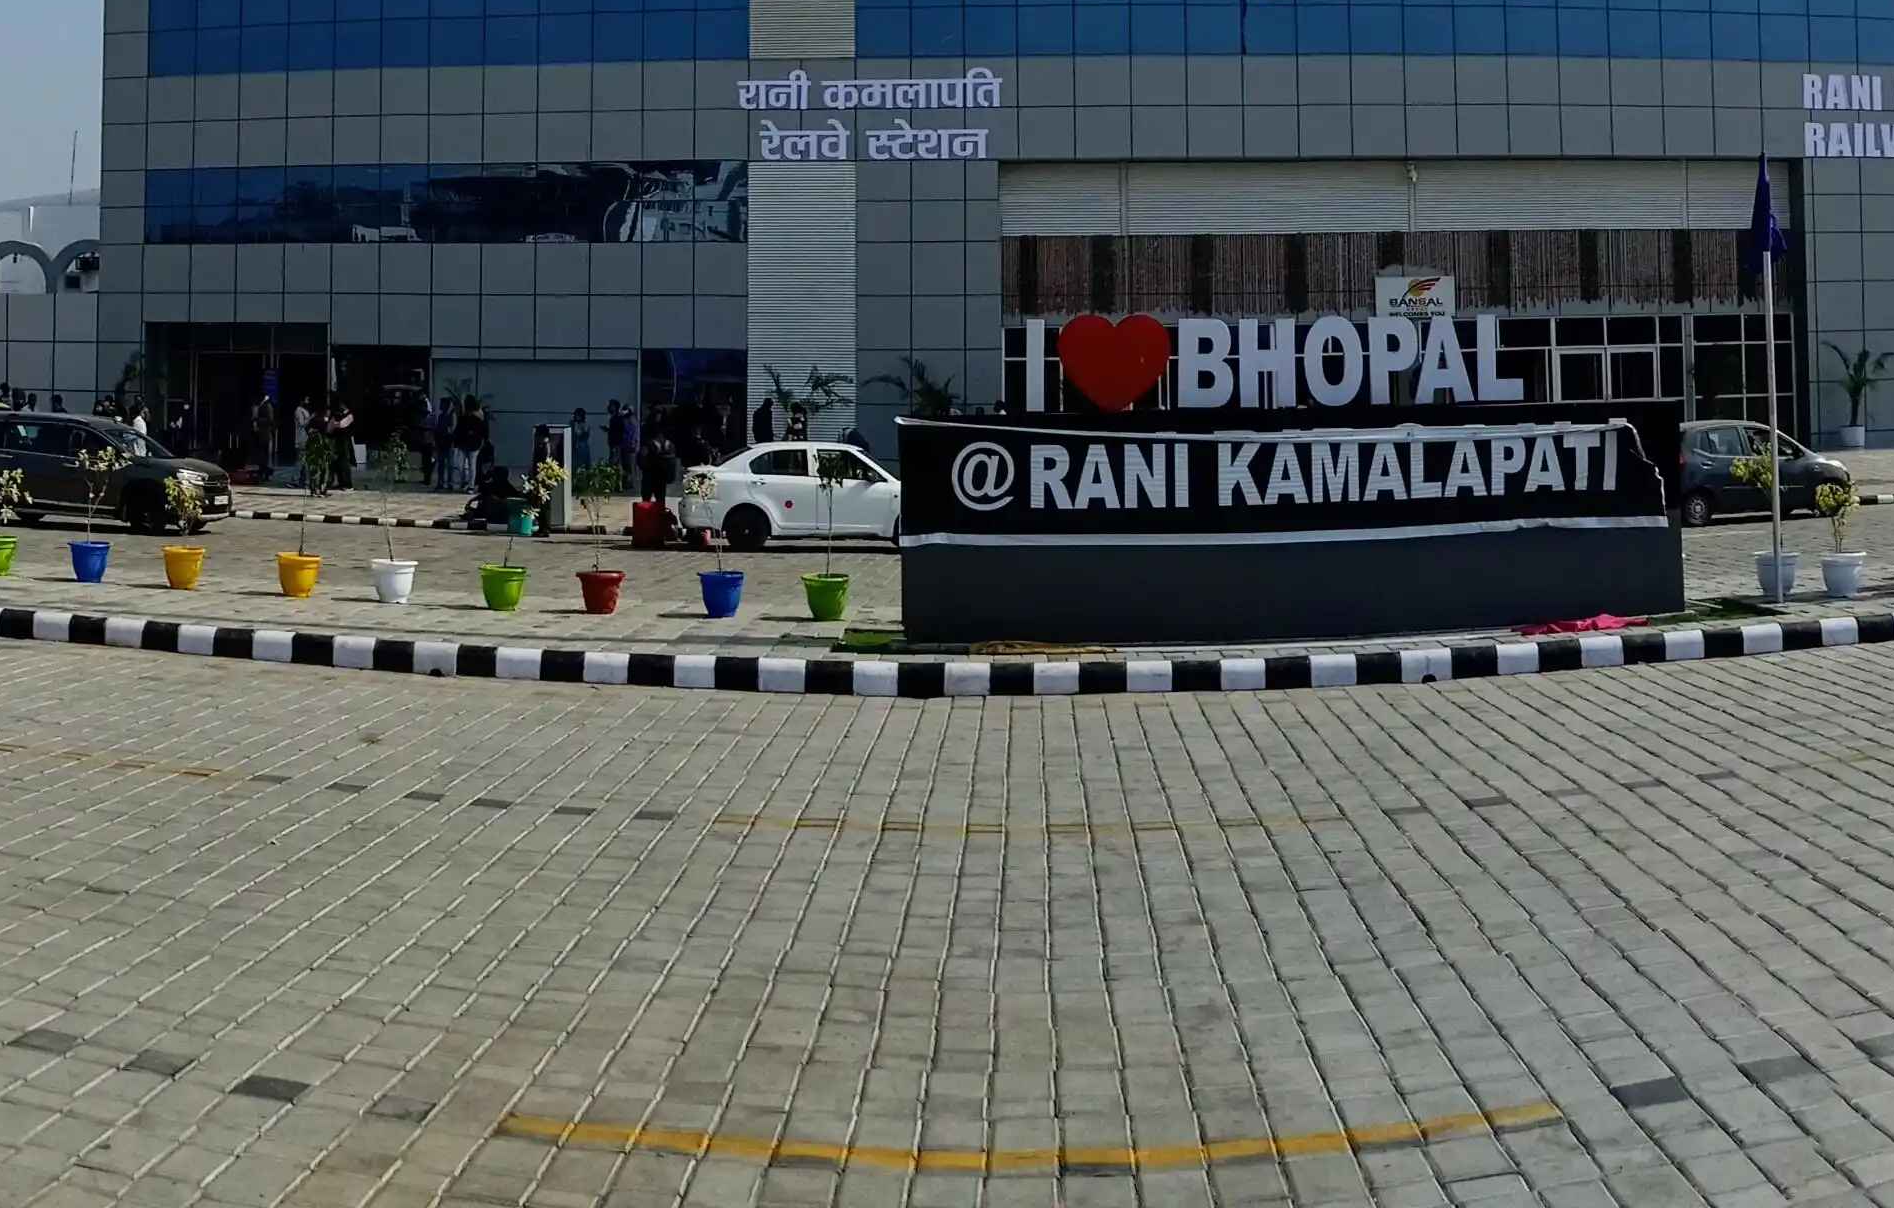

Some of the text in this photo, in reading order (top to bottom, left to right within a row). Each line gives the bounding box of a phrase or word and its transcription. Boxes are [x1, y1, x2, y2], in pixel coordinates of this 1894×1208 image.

[737, 67, 1003, 109] रानी कमलापति
[1803, 74, 1882, 110] RANI
[759, 118, 989, 160] रेलवे स्टेशन
[1389, 297, 1443, 307] BANSAL
[1026, 314, 1524, 412] I BHOPAL
[1030, 443, 1189, 509] RANI
[1218, 432, 1618, 506] KAMALAPATI
